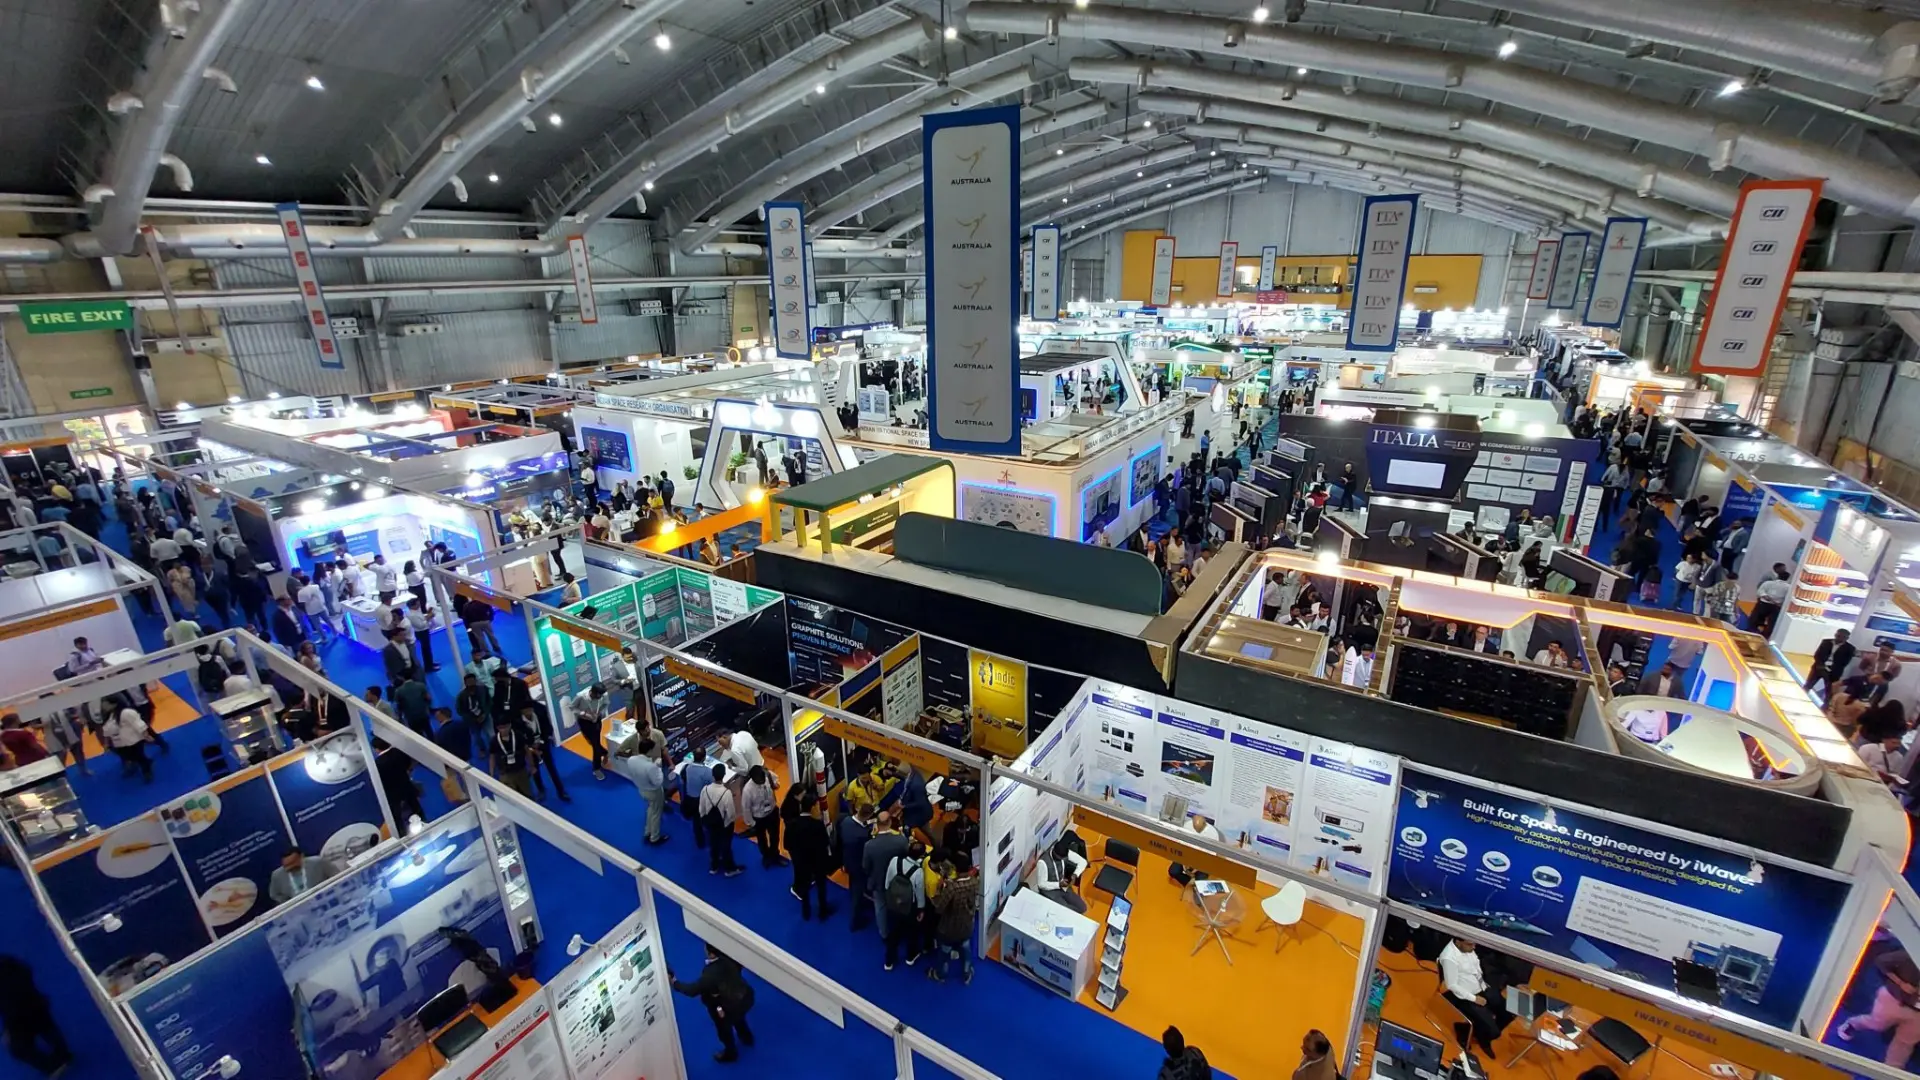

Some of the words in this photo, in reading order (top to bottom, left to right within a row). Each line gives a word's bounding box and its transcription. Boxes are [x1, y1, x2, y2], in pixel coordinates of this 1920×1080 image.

[950, 177, 991, 185] AUSTRALIA
[1762, 208, 1785, 218] CII
[1752, 243, 1774, 252] CII
[1742, 277, 1763, 286] CII
[30, 312, 77, 324] FIRE
[80, 310, 124, 322] EXIT
[1732, 309, 1754, 319] CII
[1723, 342, 1744, 350] CII
[611, 399, 626, 408] SPACE
[652, 403, 689, 415] ORGANISATION
[901, 429, 919, 438] SPACE
[1372, 429, 1440, 449] ITALIA
[1487, 442, 1522, 450] COMPANIES
[1565, 471, 1583, 508] ITALIA
[1580, 497, 1600, 537] ITALIA
[791, 622, 825, 638] GRAPHITE
[825, 632, 864, 650] SOLUTIONS
[792, 631, 820, 645] PROVEN
[828, 641, 851, 654] SPACE
[654, 680, 686, 699] NOTHING
[1242, 726, 1259, 735] Aimil
[1463, 798, 1495, 815] Built
[1497, 806, 1519, 821] for
[1519, 814, 1572, 836] Space.
[1573, 828, 1667, 862] Engineered
[1667, 853, 1692, 870] by
[1465, 812, 1529, 836] High-reliability
[1529, 830, 1571, 847] adaptive
[1571, 842, 1625, 864] computing
[1625, 856, 1675, 876] platforms
[1676, 871, 1726, 890] designed
[1726, 883, 1744, 895] for
[1514, 834, 1601, 864] radiation-intensive
[1600, 859, 1632, 874] space
[1632, 868, 1678, 886] missions.
[1047, 952, 1070, 968] Aimil
[1634, 1010, 1670, 1029] IWAVE
[1673, 1025, 1718, 1046] GLOBAL
